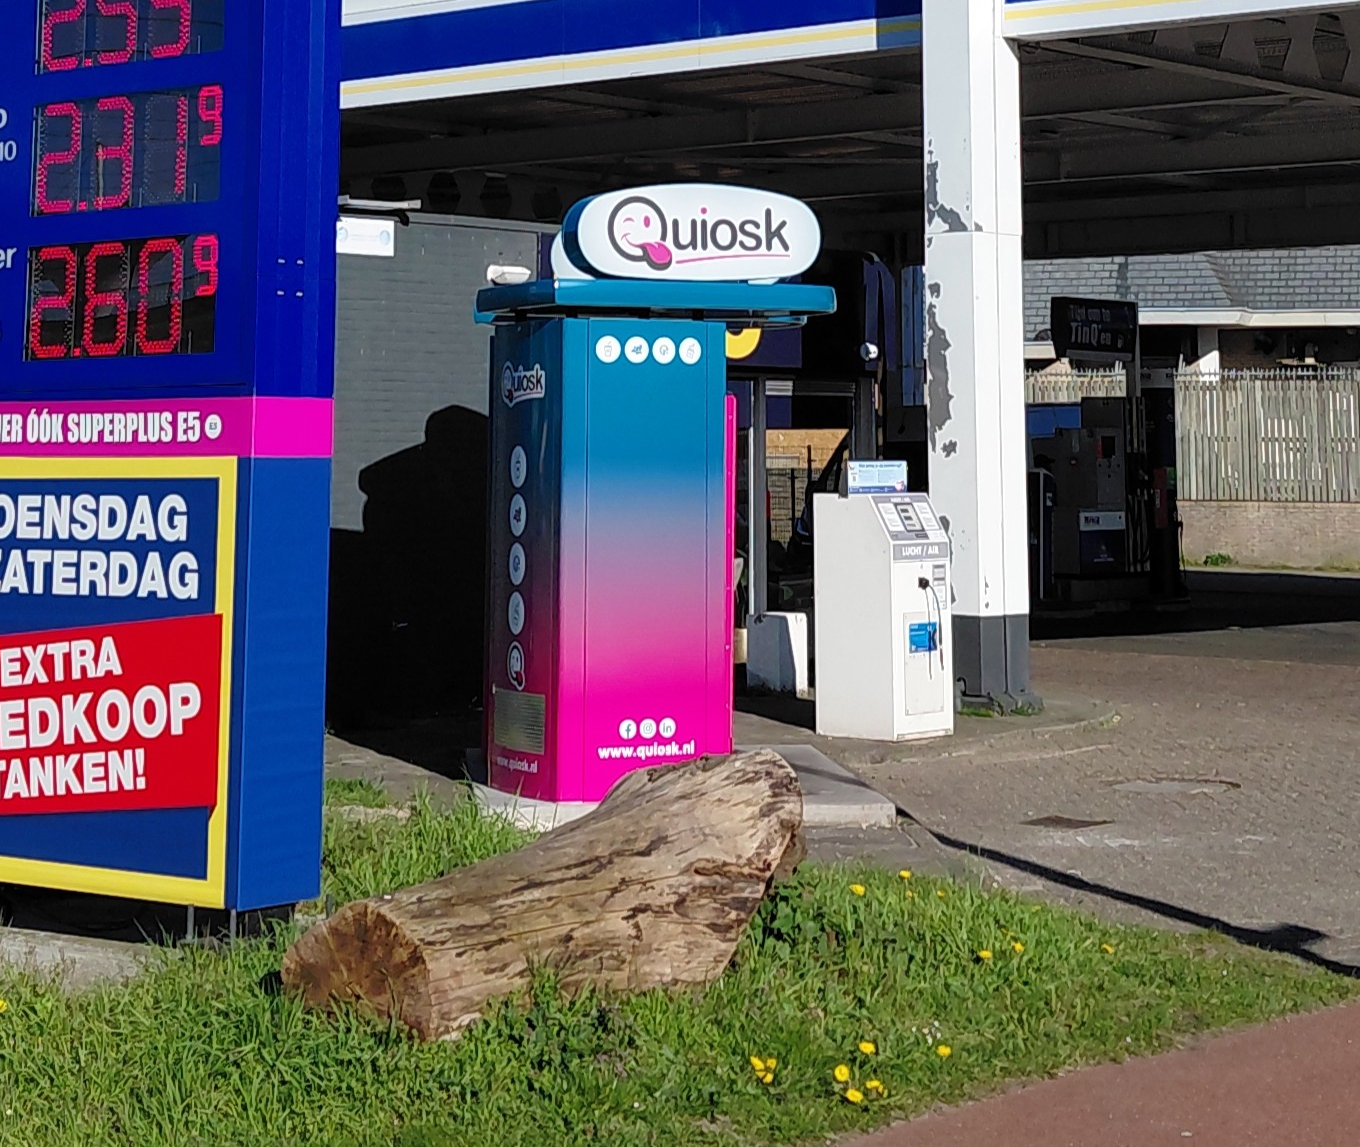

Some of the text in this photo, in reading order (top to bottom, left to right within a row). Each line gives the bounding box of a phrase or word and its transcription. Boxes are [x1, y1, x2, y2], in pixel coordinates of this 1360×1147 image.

[607, 195, 790, 271] Quiosk
[26, 408, 65, 444] ÓÓK
[67, 411, 173, 445] SUPERPLUS
[176, 411, 201, 444] E5
[0, 636, 123, 688] EXTRA
[597, 739, 695, 761] www.quiosk.nl
